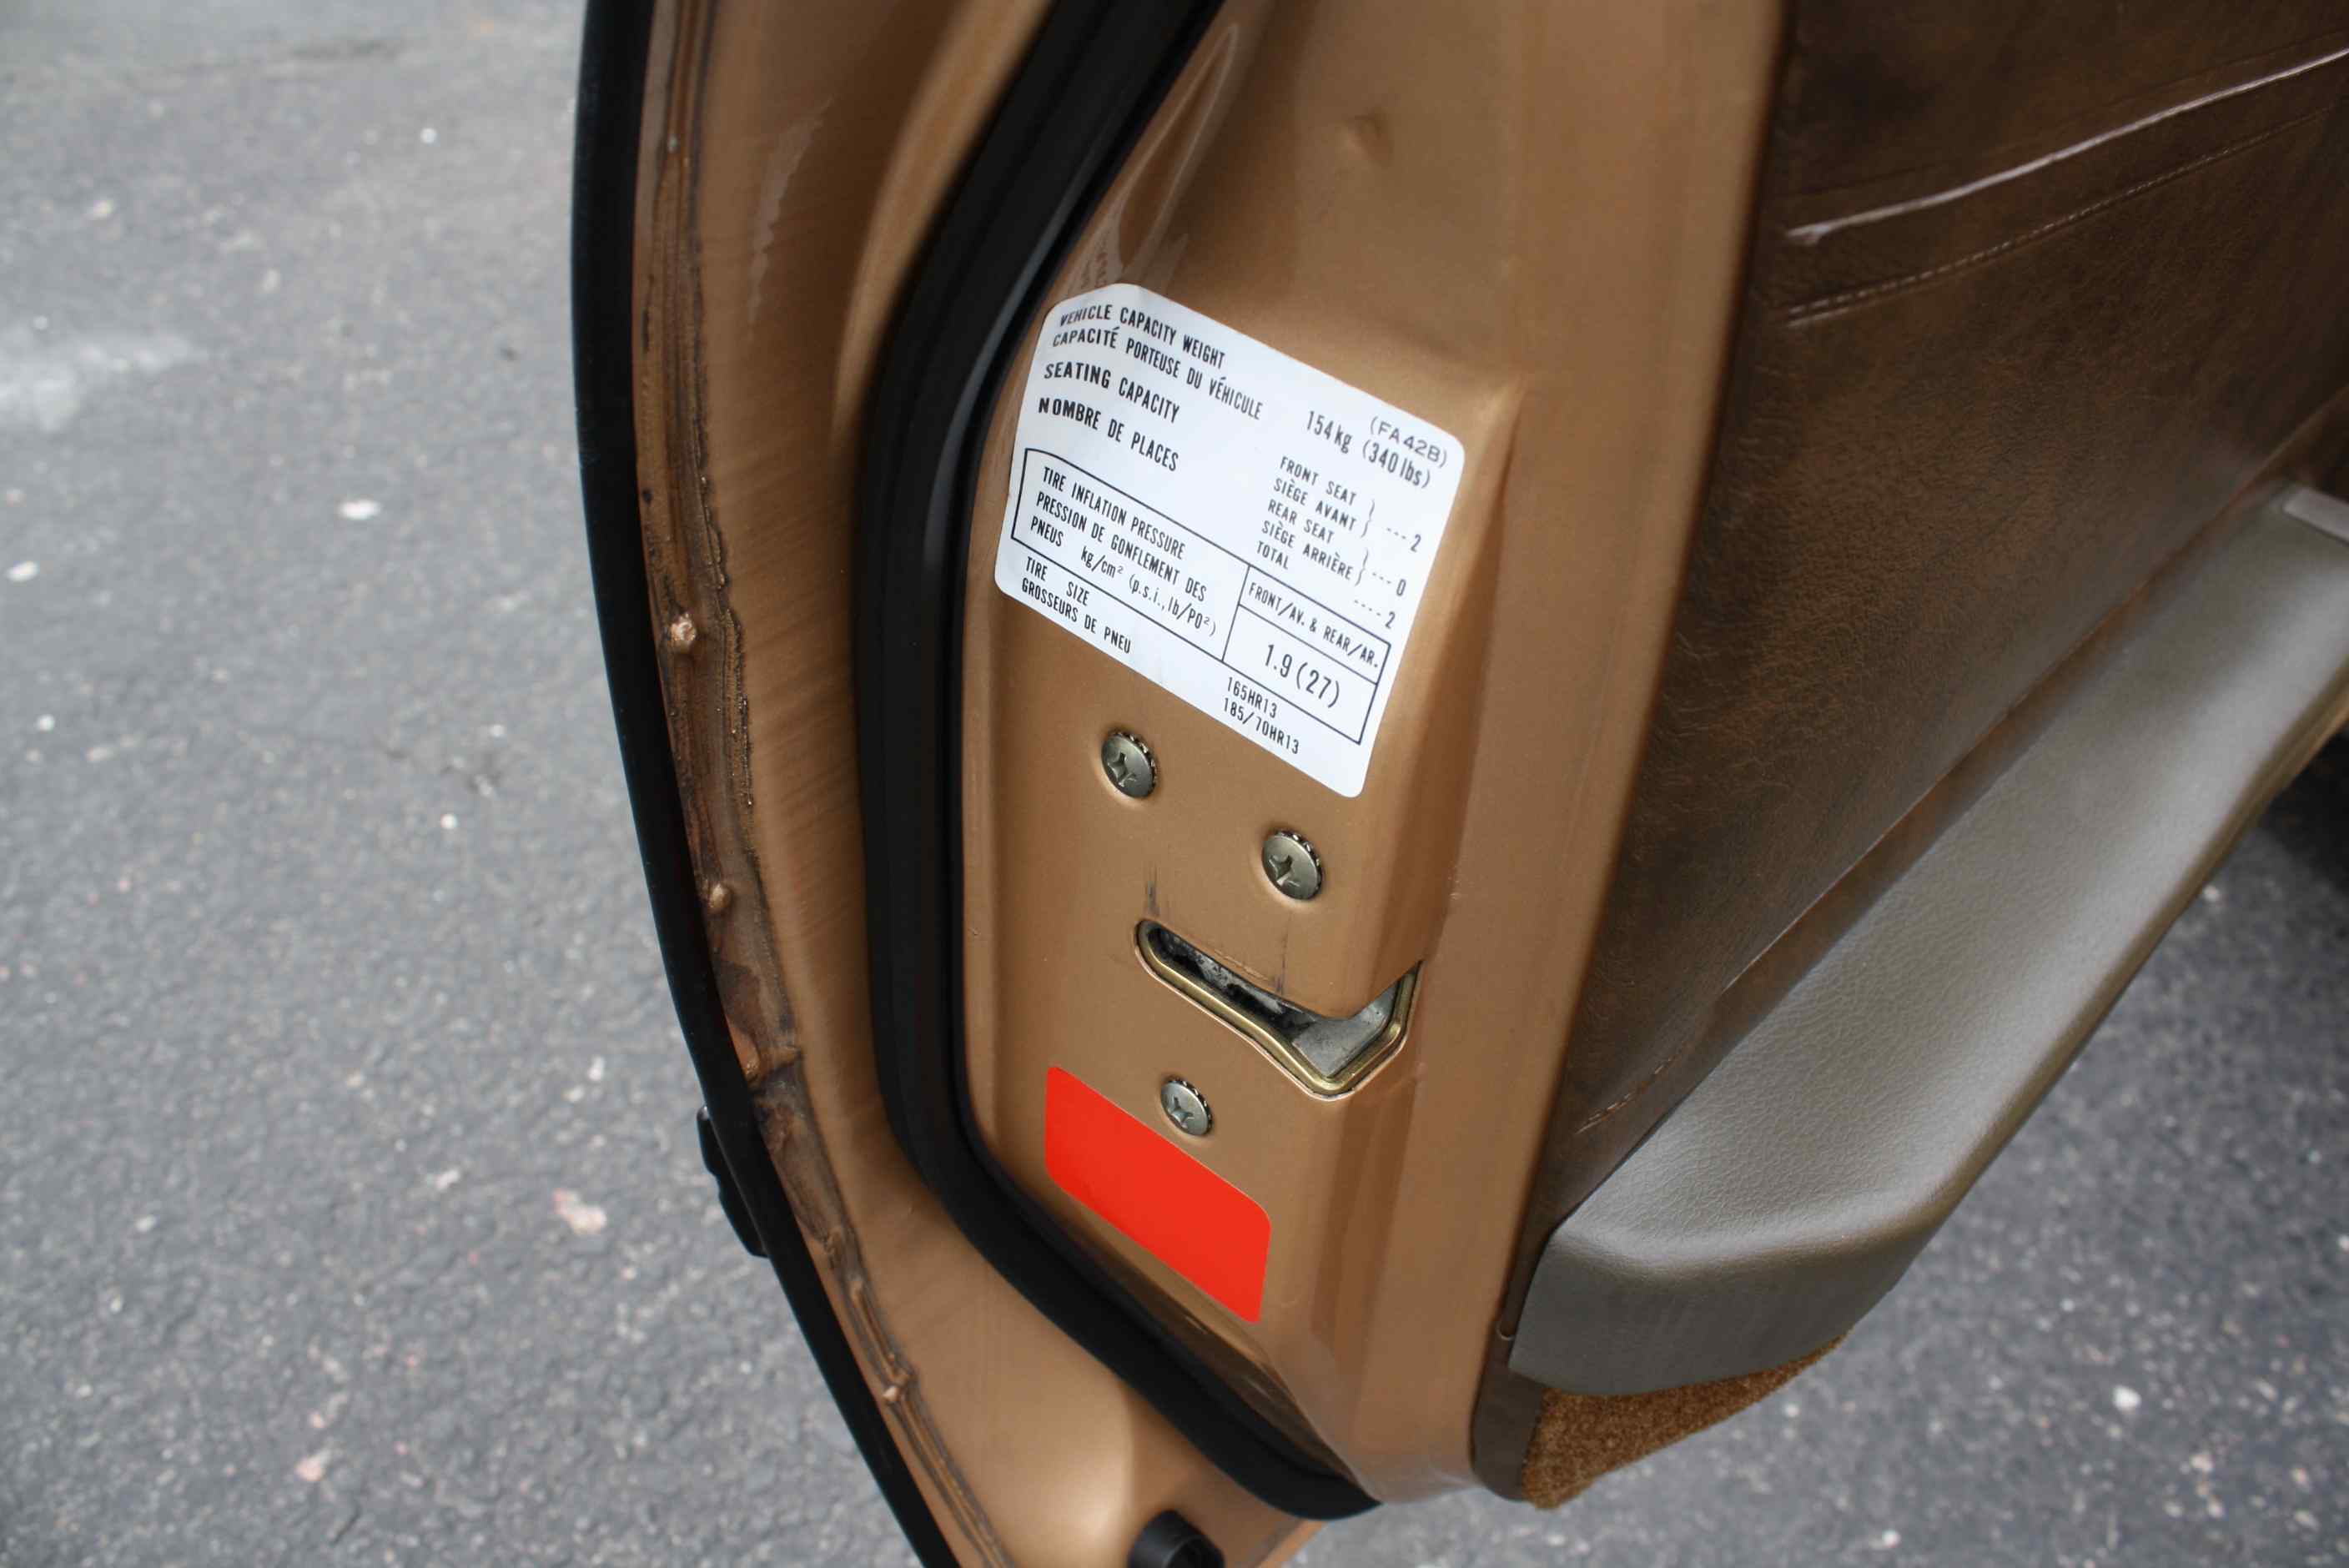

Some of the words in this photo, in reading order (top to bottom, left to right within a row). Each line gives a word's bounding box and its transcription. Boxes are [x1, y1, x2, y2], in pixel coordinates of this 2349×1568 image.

[1059, 304, 1114, 328] VEHICLE
[1119, 306, 1177, 346] CAPACITY
[1182, 334, 1225, 369] WEIGHT
[1044, 361, 1112, 389] SEATING
[1118, 376, 1180, 424] CAPACITY
[1052, 326, 1120, 349] CAPACITÉ
[1125, 337, 1181, 379] PORTEUSE
[1185, 366, 1204, 389] DU
[1209, 376, 1264, 420] VÉHICULE
[1038, 396, 1102, 431] NOMBRE
[1107, 418, 1125, 443] DE
[1130, 431, 1179, 472] PLACES
[1371, 416, 1447, 468] (FA42B)
[1273, 477, 1309, 506] SIÈGE
[1315, 500, 1357, 531] AVANT
[1280, 455, 1319, 486] FRONT
[1325, 480, 1357, 506] SEAT
[1030, 515, 1064, 548] PNEUS
[1043, 465, 1067, 493] TIRE
[1070, 481, 1127, 526] INFLATION
[1130, 515, 1185, 560] PRESSURE
[1267, 498, 1298, 525] REAR
[1303, 519, 1334, 544] SEAT
[1035, 490, 1088, 533] PRESSION
[1090, 521, 1106, 543] DE
[1110, 534, 1180, 585] GONFLEMENT
[1185, 576, 1207, 602] DES
[1256, 540, 1289, 570] TOTAL
[1261, 520, 1295, 548] SIÈGE
[1302, 543, 1354, 580] ARRIÈRE
[1025, 555, 1049, 581] TIRE
[1065, 580, 1090, 606] SIZE
[1021, 576, 1079, 623] GROSSEURS
[1084, 613, 1098, 635] DE
[1104, 626, 1131, 655] PNEU
[1309, 617, 1318, 633] &
[1224, 696, 1300, 755] 185/70HR13
[1227, 676, 1278, 719] 165HR13
